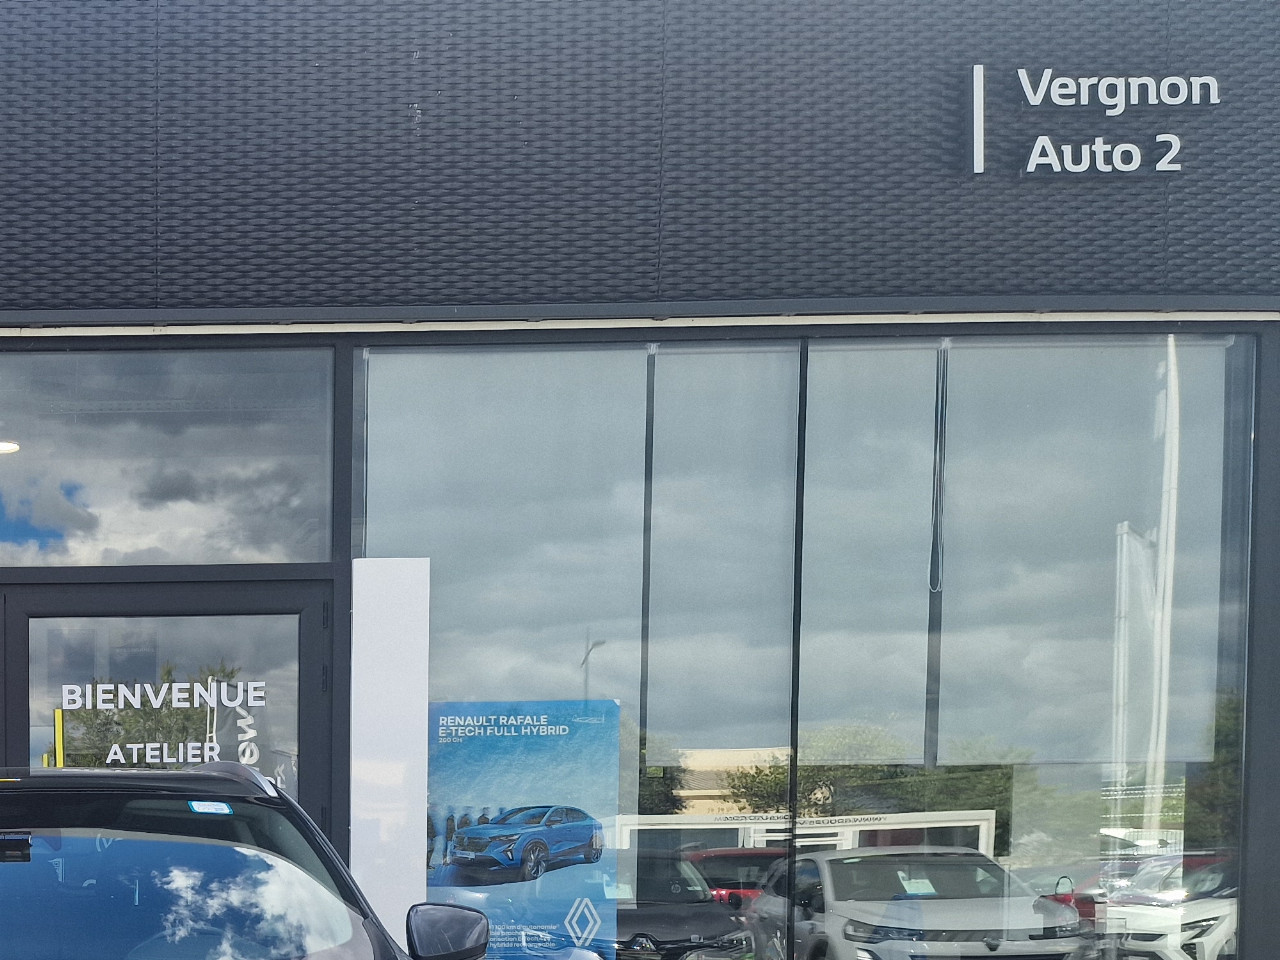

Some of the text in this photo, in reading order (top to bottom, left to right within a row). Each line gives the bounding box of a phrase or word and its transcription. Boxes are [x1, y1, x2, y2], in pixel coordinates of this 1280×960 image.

[1017, 68, 1220, 116] Vergnon
[1026, 134, 1182, 173] Auto 2
[62, 681, 266, 710] BIENVENUE
[438, 725, 569, 737] E-TECH FULL HYBRID
[439, 715, 548, 726] RENAULT RAFALE
[105, 742, 220, 764] ATELIER
